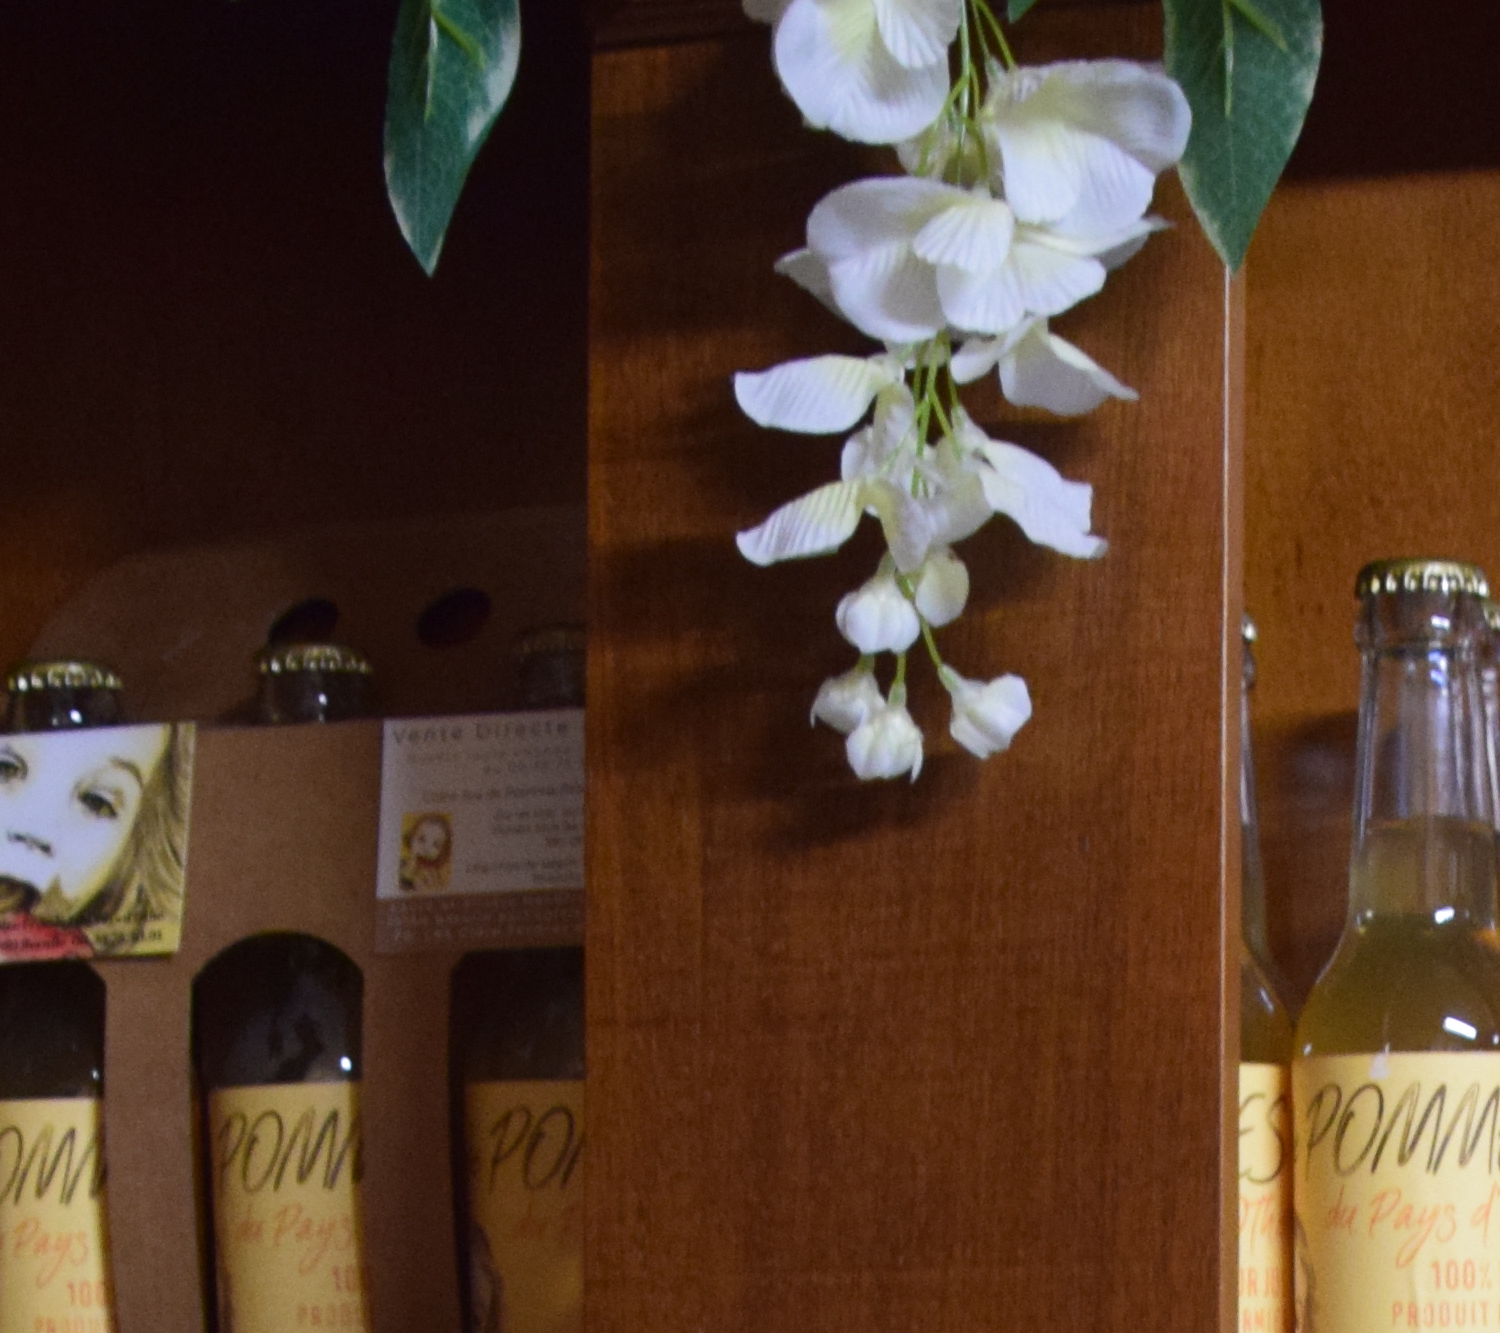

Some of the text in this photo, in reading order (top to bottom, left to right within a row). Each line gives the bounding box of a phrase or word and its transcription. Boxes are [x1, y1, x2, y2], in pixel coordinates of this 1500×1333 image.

[392, 727, 462, 743] Vente
[1327, 1184, 1457, 1269] du Pays
[15, 1216, 89, 1290] Pays
[1432, 1258, 1492, 1290] 100%
[1392, 1300, 1488, 1327] PRODUIT
